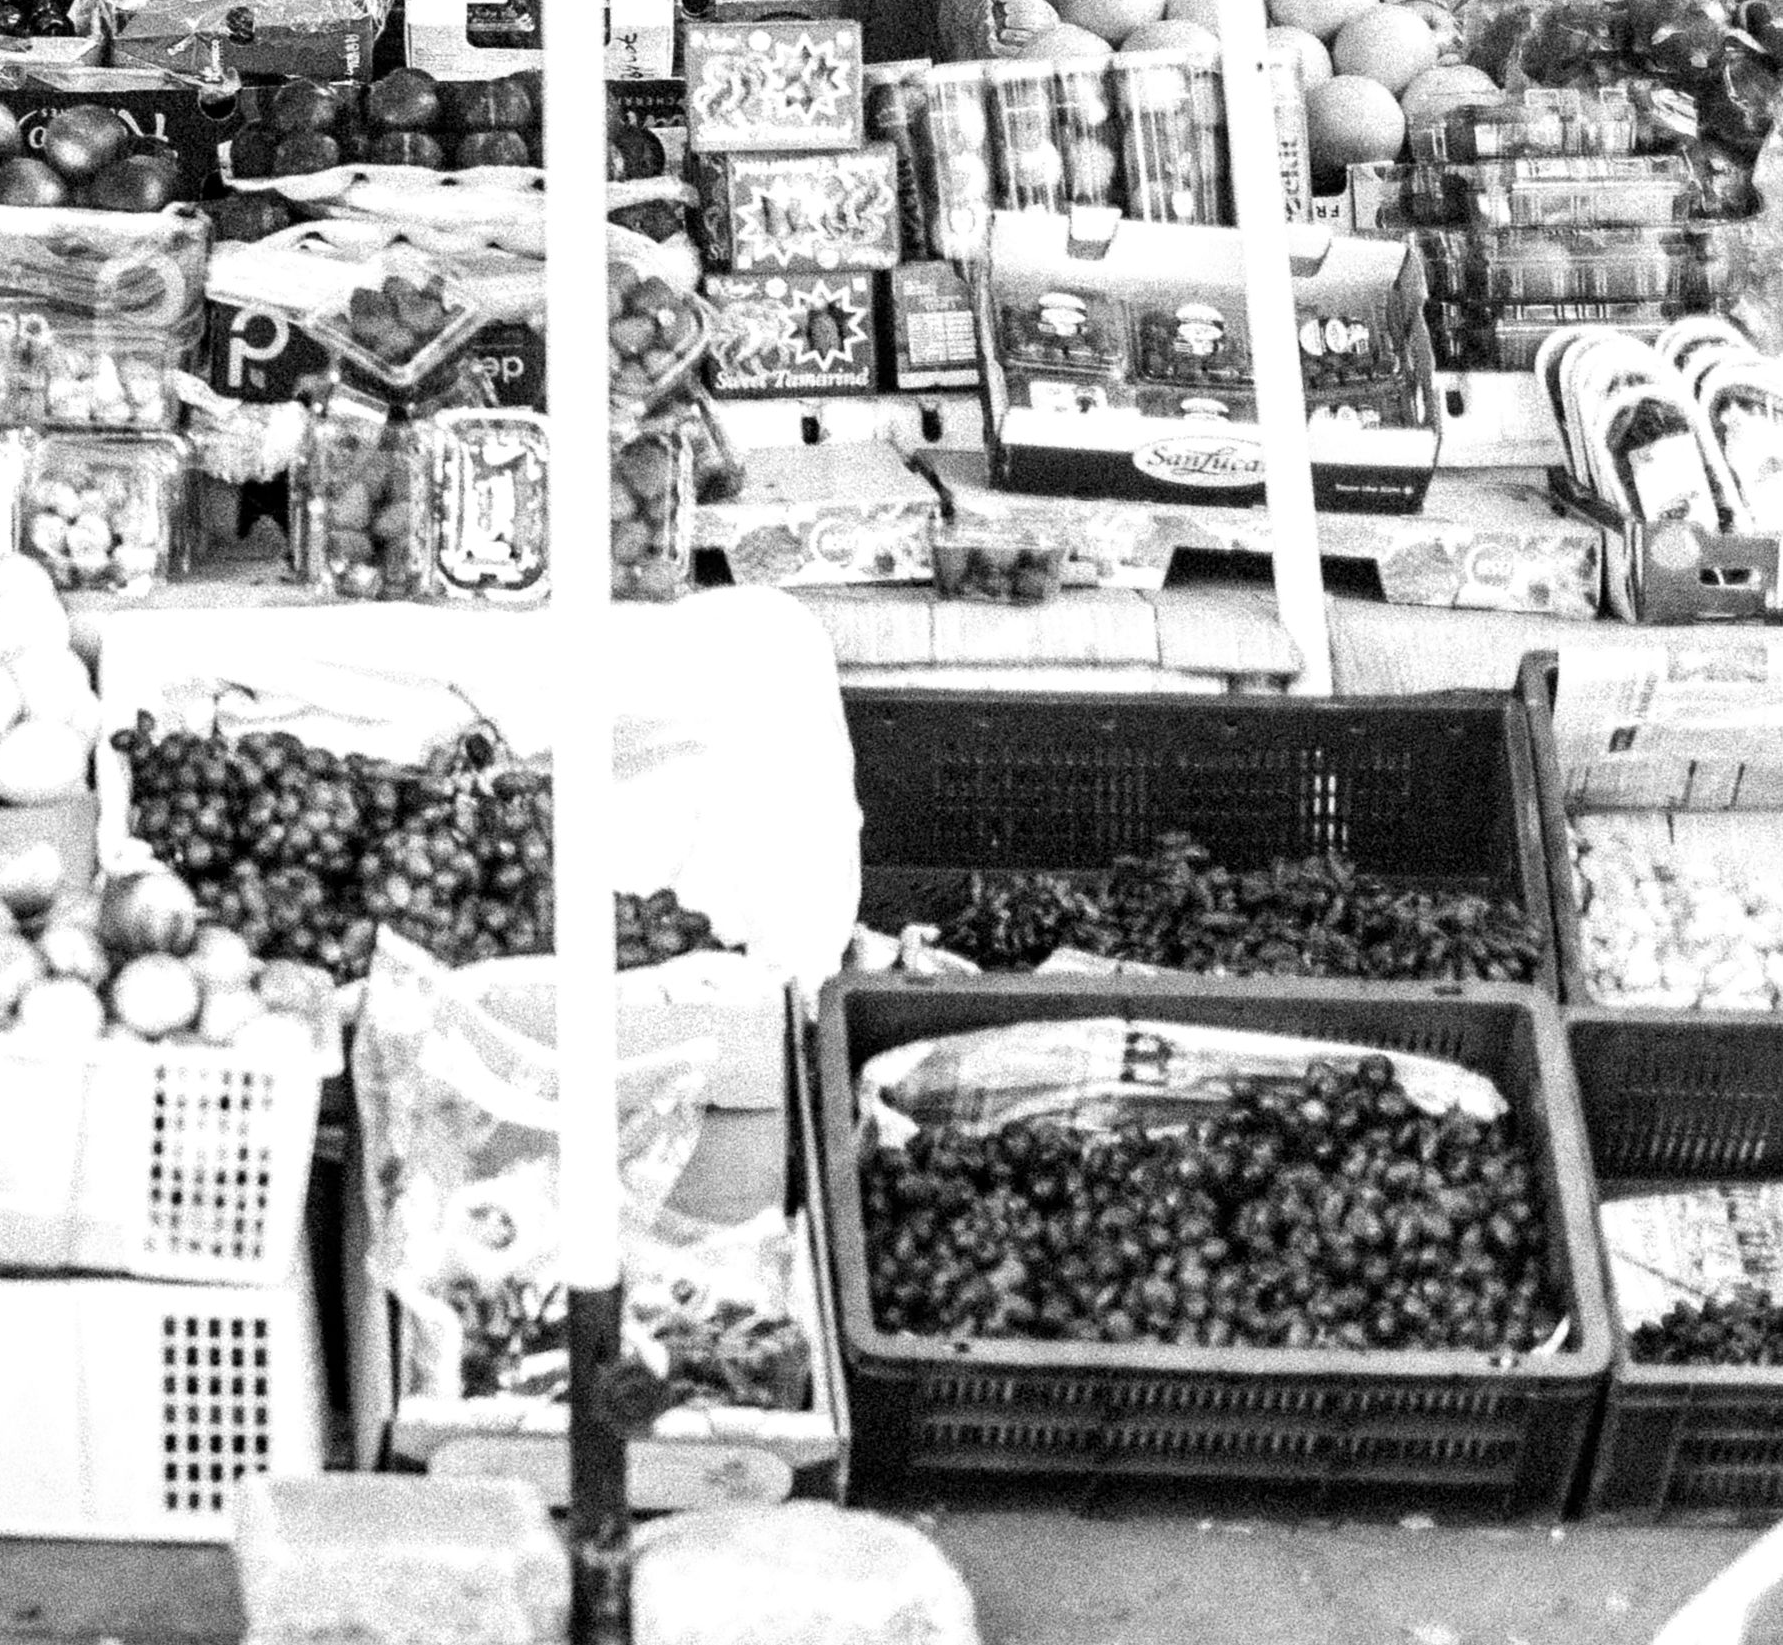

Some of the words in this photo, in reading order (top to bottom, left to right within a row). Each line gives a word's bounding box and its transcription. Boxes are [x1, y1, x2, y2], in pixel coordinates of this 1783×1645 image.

[715, 370, 768, 391] Sweet
[774, 366, 869, 389] Tamarind
[1146, 444, 1262, 475] SanLuca
